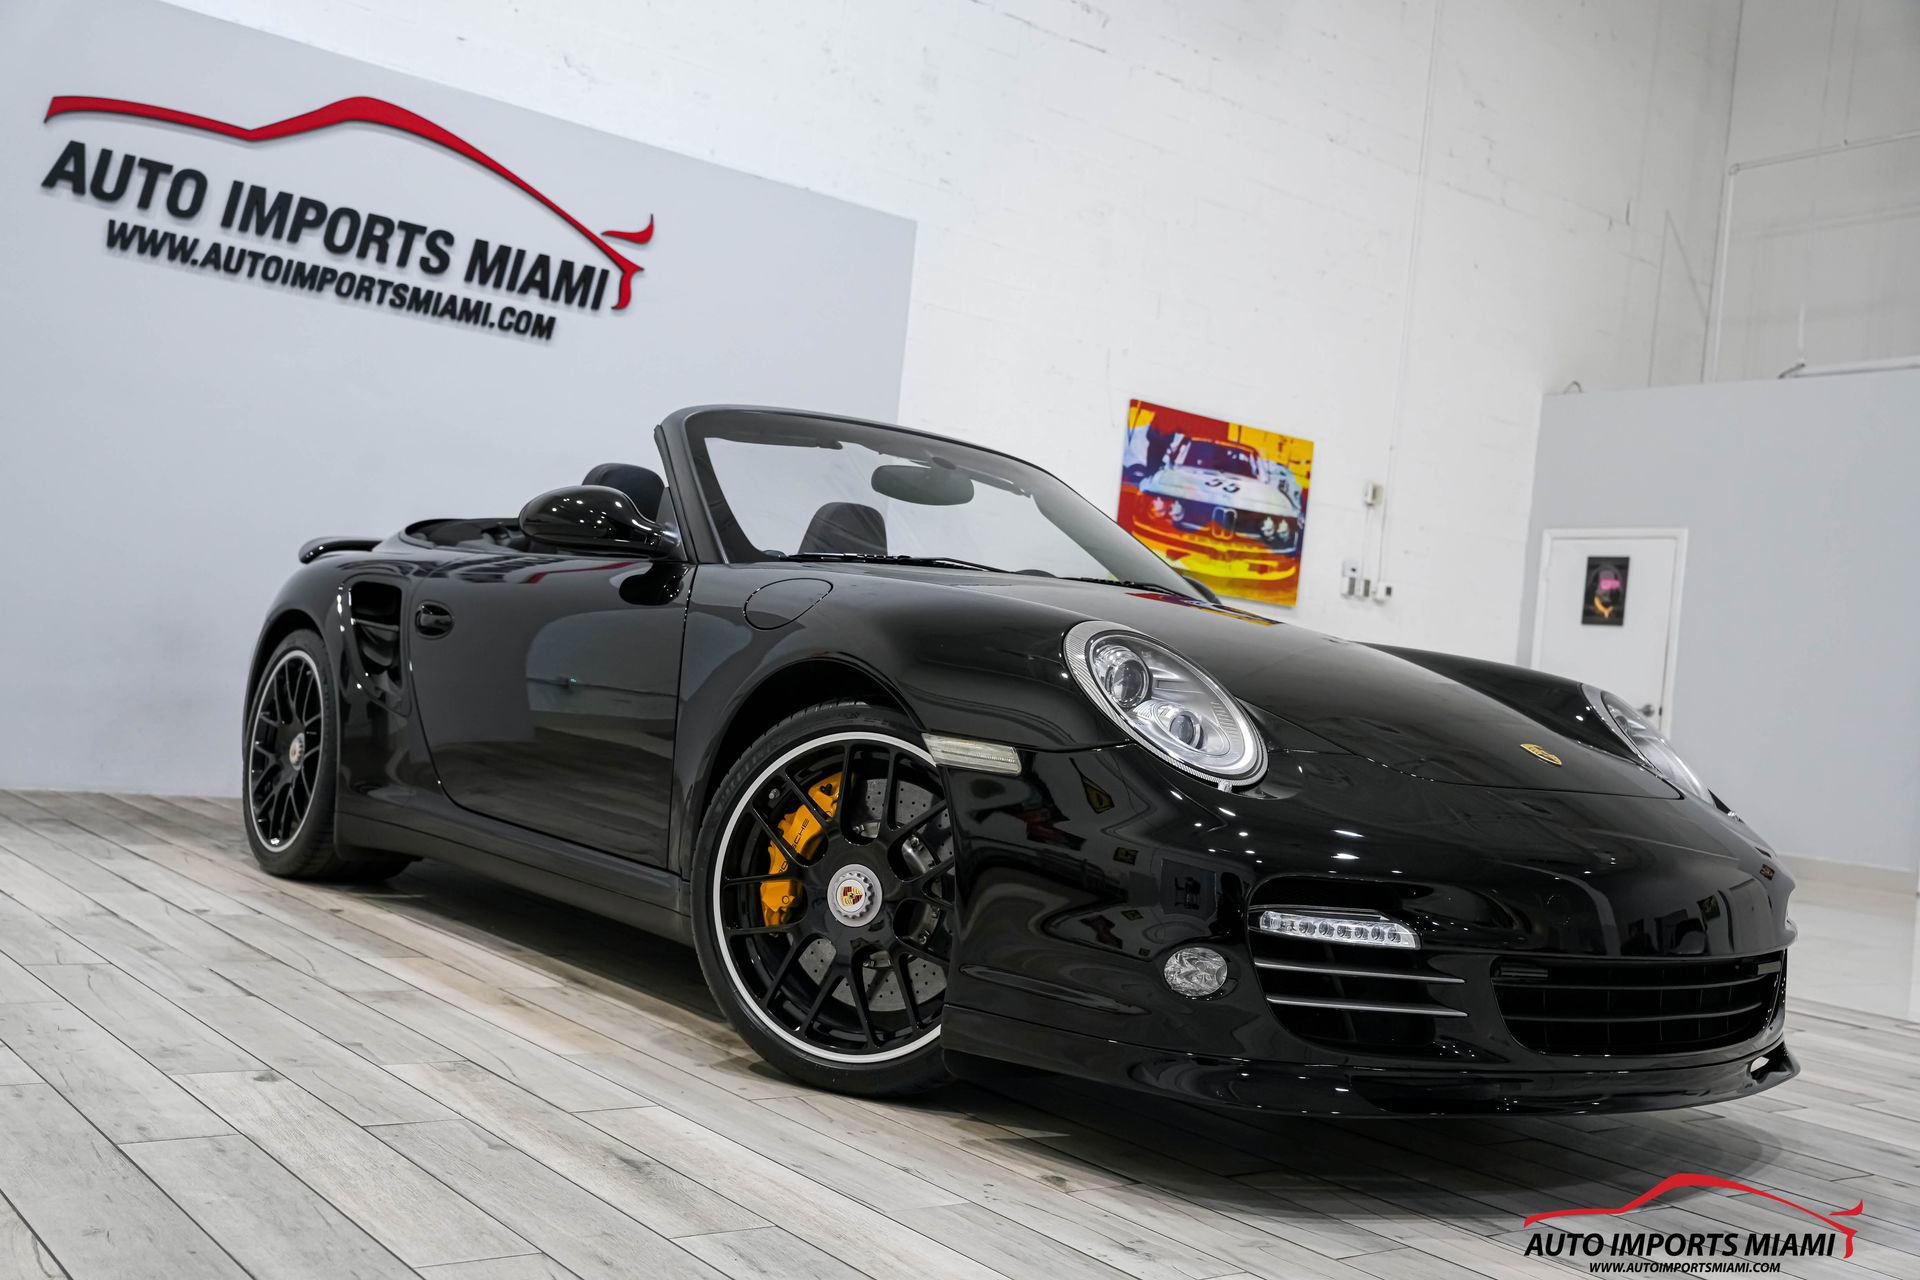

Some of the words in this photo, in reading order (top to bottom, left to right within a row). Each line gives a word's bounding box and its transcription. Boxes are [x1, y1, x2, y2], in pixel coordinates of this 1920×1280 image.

[40, 140, 208, 220] AUTO
[220, 180, 455, 276] IMPORTS
[464, 239, 610, 311] MIAMI
[106, 219, 556, 340] WWW.AUTOIMPORTSMIAMI.COM
